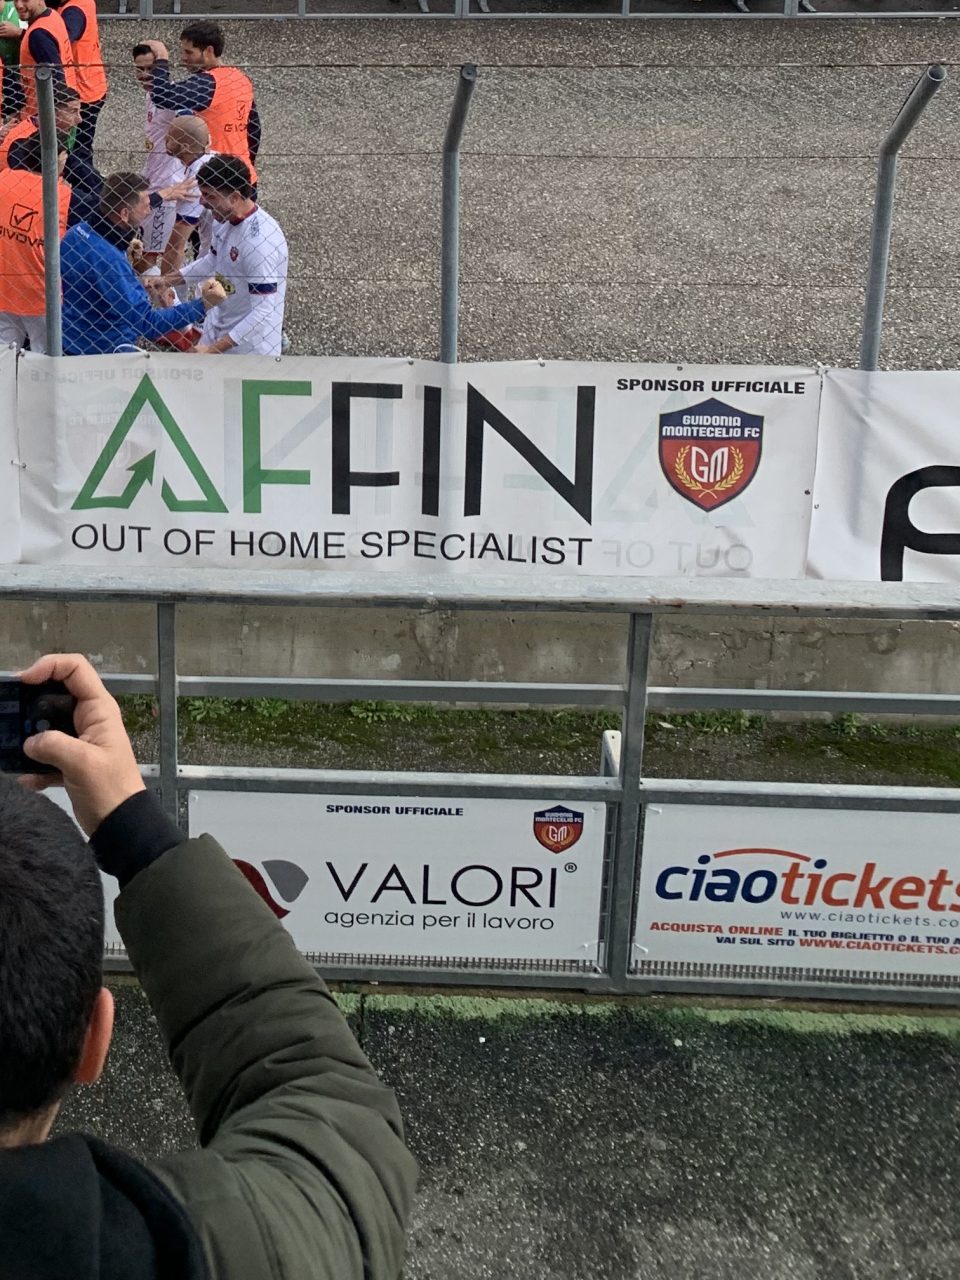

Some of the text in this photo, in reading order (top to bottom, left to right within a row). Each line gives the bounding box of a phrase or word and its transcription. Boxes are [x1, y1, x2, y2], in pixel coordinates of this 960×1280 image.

[616, 378, 805, 395] SPONSOR UFFICIALE
[682, 414, 741, 427] GUIDONIA
[662, 426, 760, 438] MONTECELIO FC
[71, 523, 593, 566] OUT OF HOME SPECIALIST
[326, 804, 464, 816] SPONSOR UFFICIALE
[325, 861, 557, 908] VALORI
[324, 911, 554, 930] agenzia per il lavoro
[781, 910, 959, 928] www.ciaotickets.co
[650, 922, 723, 934] ACQUISTA
[729, 925, 783, 936] ONLINE
[788, 929, 799, 937] IL
[802, 929, 827, 938] TUO
[831, 931, 894, 941] BIGLIETTO
[898, 934, 907, 942] O
[911, 935, 921, 943] IL
[926, 936, 950, 945] TUO
[716, 936, 736, 944] VAI
[740, 937, 763, 945] SUL
[767, 938, 795, 947] SITO
